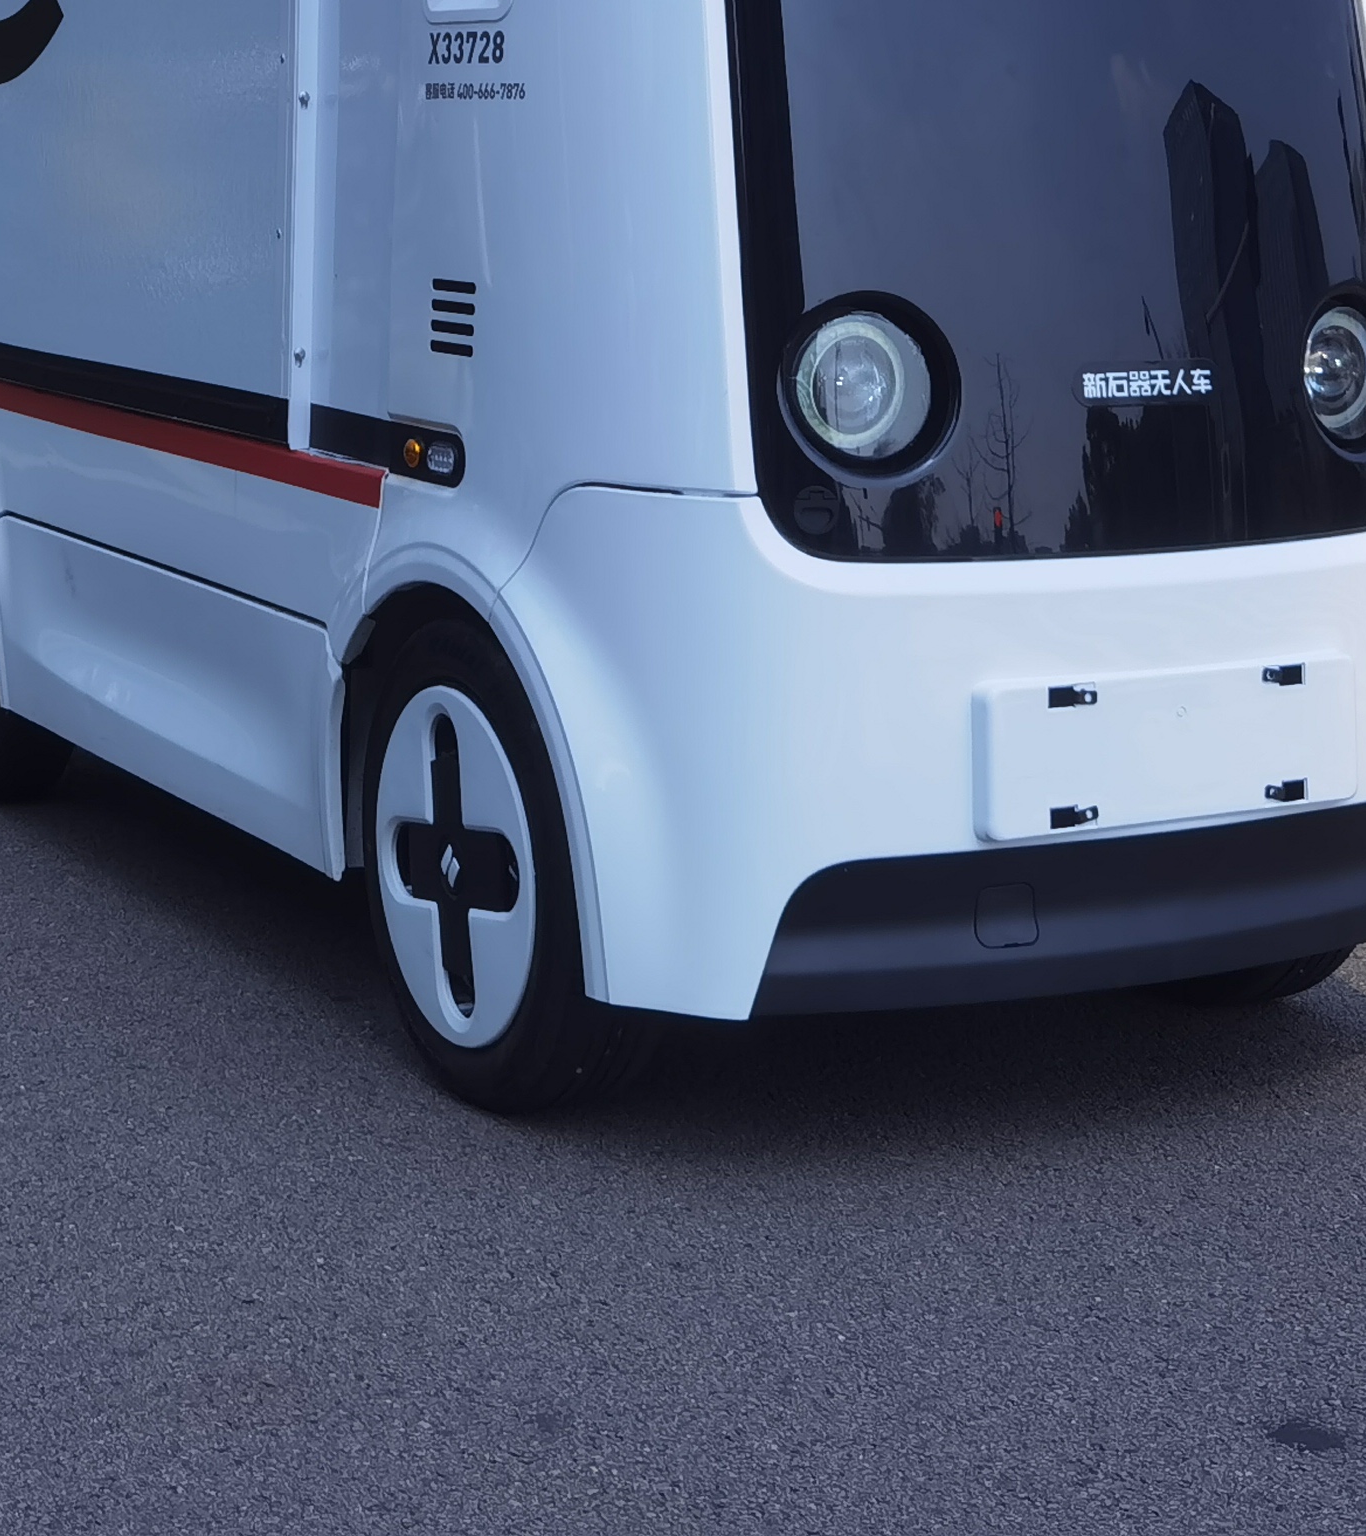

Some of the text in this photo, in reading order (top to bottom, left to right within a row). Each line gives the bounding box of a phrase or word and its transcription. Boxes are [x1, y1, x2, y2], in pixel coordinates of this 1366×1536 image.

[427, 30, 505, 65] X33728
[457, 83, 526, 100] 400-666-7876
[1082, 368, 1213, 399] 新石器无人车
